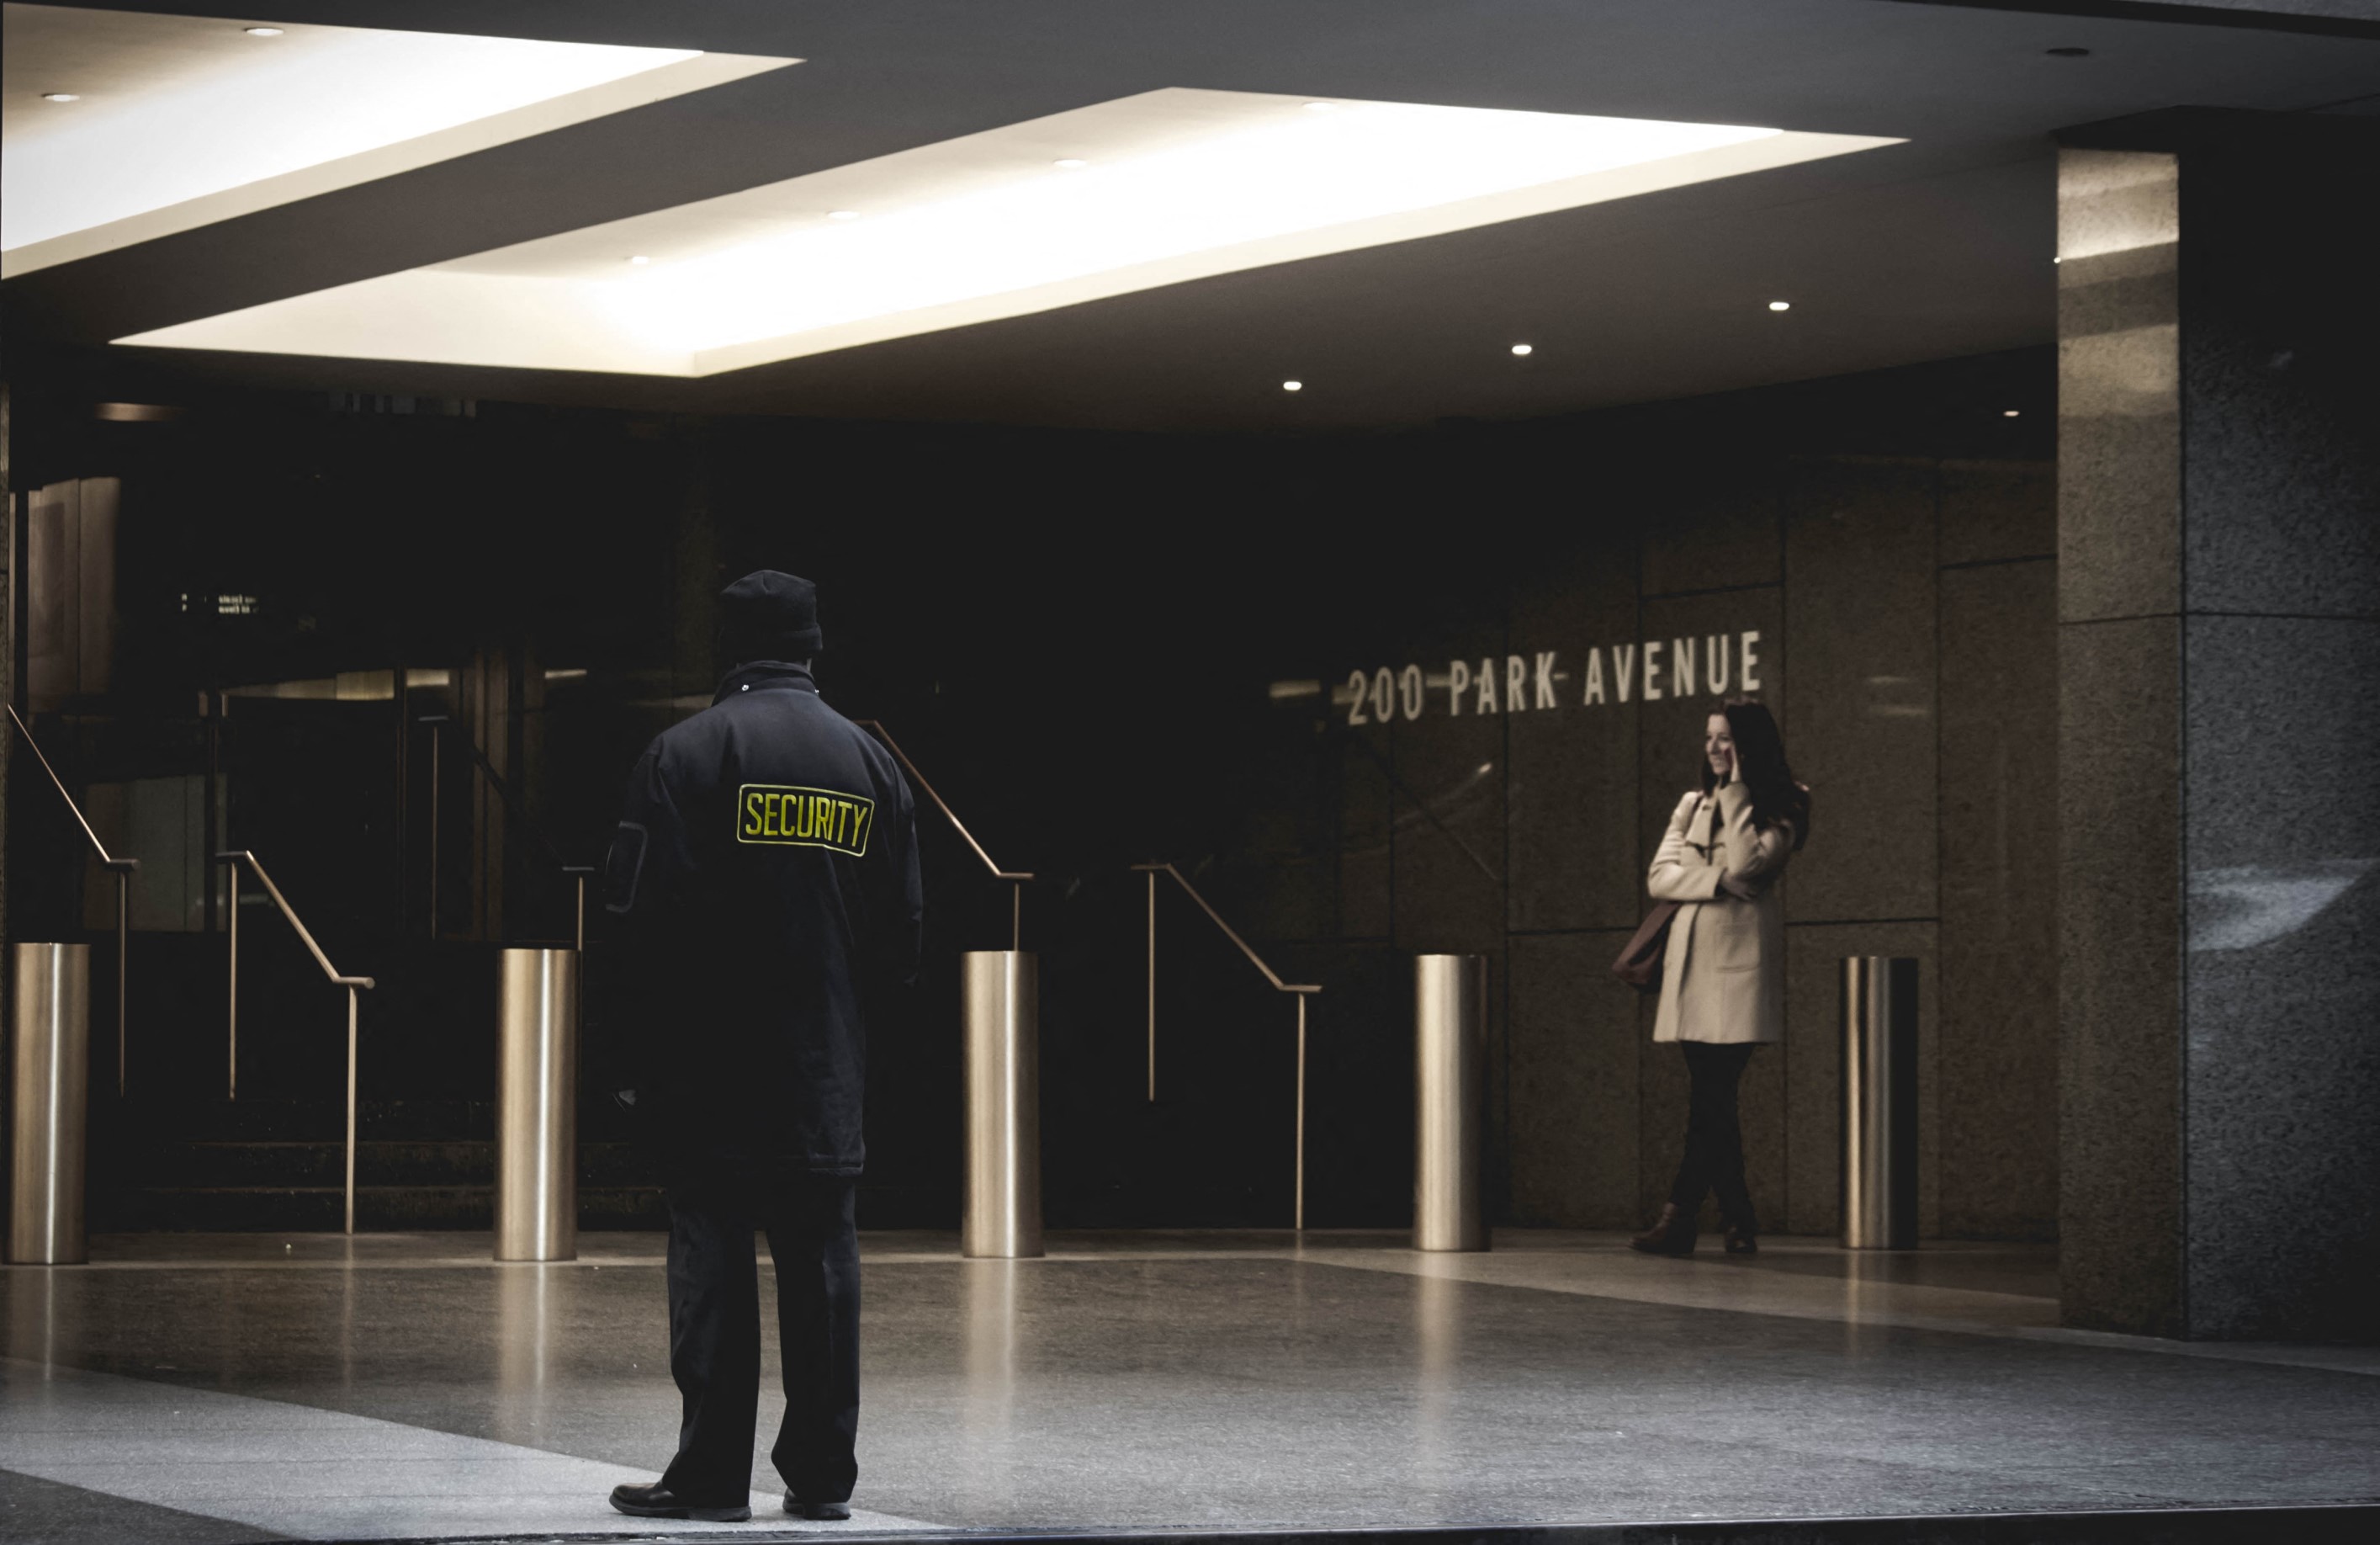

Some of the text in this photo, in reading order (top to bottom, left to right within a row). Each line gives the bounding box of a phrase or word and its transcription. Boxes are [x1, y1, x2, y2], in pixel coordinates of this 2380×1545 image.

[1349, 631, 1761, 725] 200 PARK AVENUE
[745, 792, 868, 847] SECURITY
